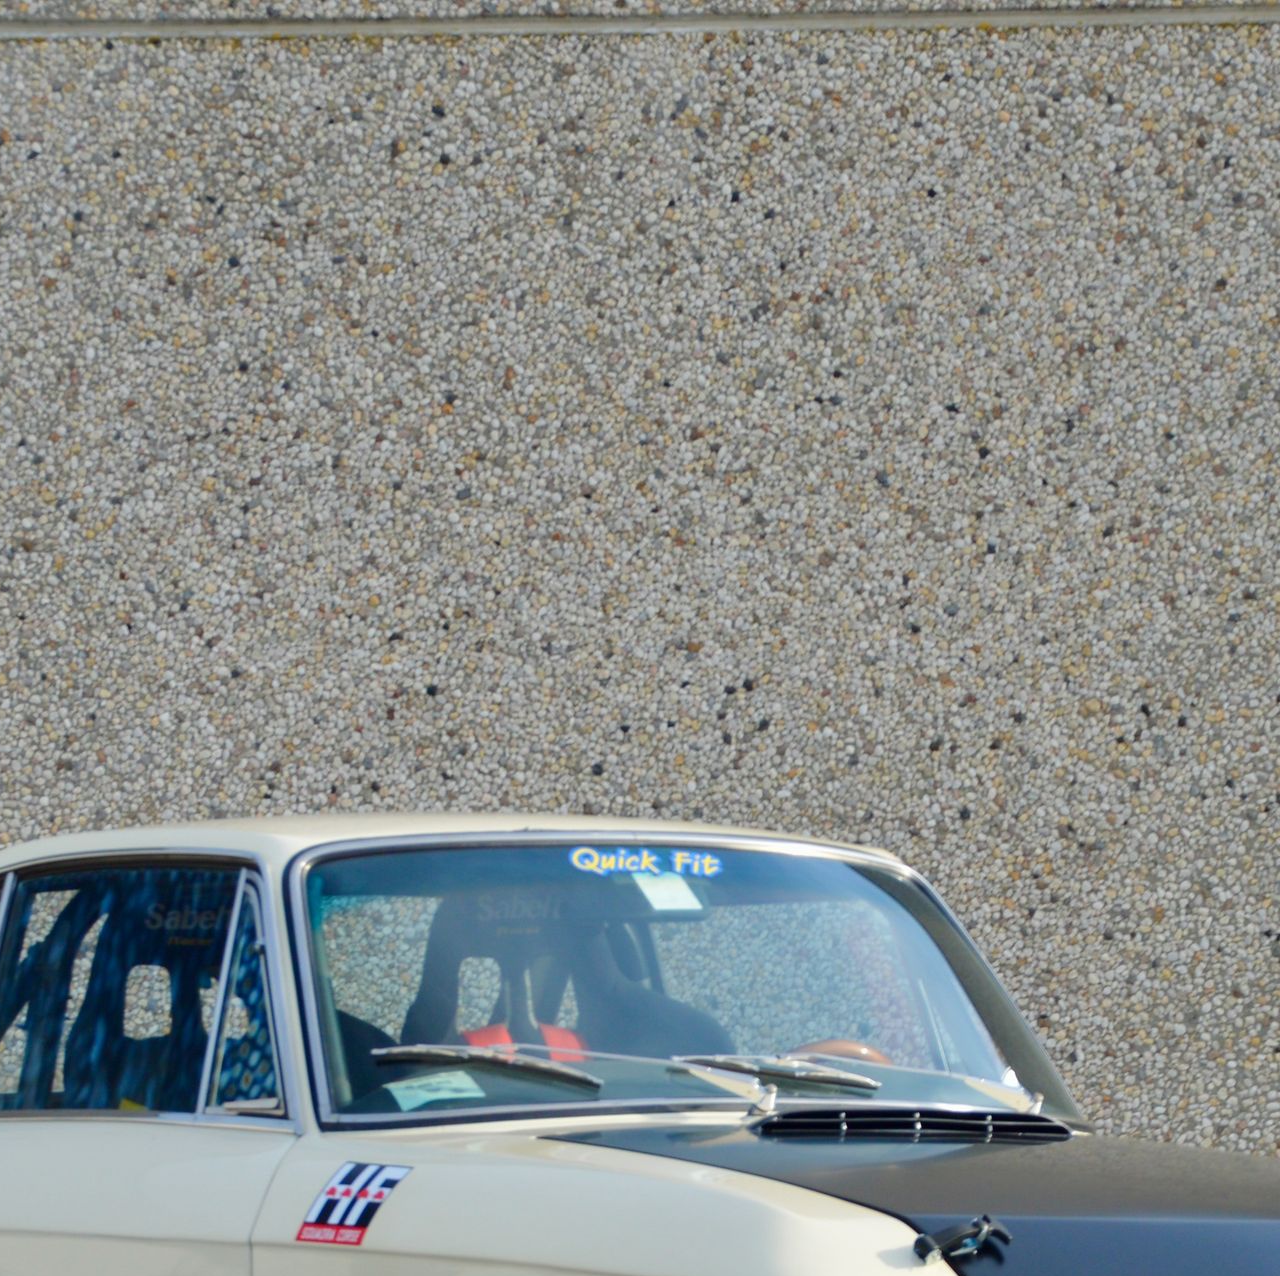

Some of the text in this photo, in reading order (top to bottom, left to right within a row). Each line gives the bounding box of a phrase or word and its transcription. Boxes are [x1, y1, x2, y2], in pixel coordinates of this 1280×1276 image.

[571, 847, 721, 877] Quick Fit
[304, 1162, 412, 1226] HF
